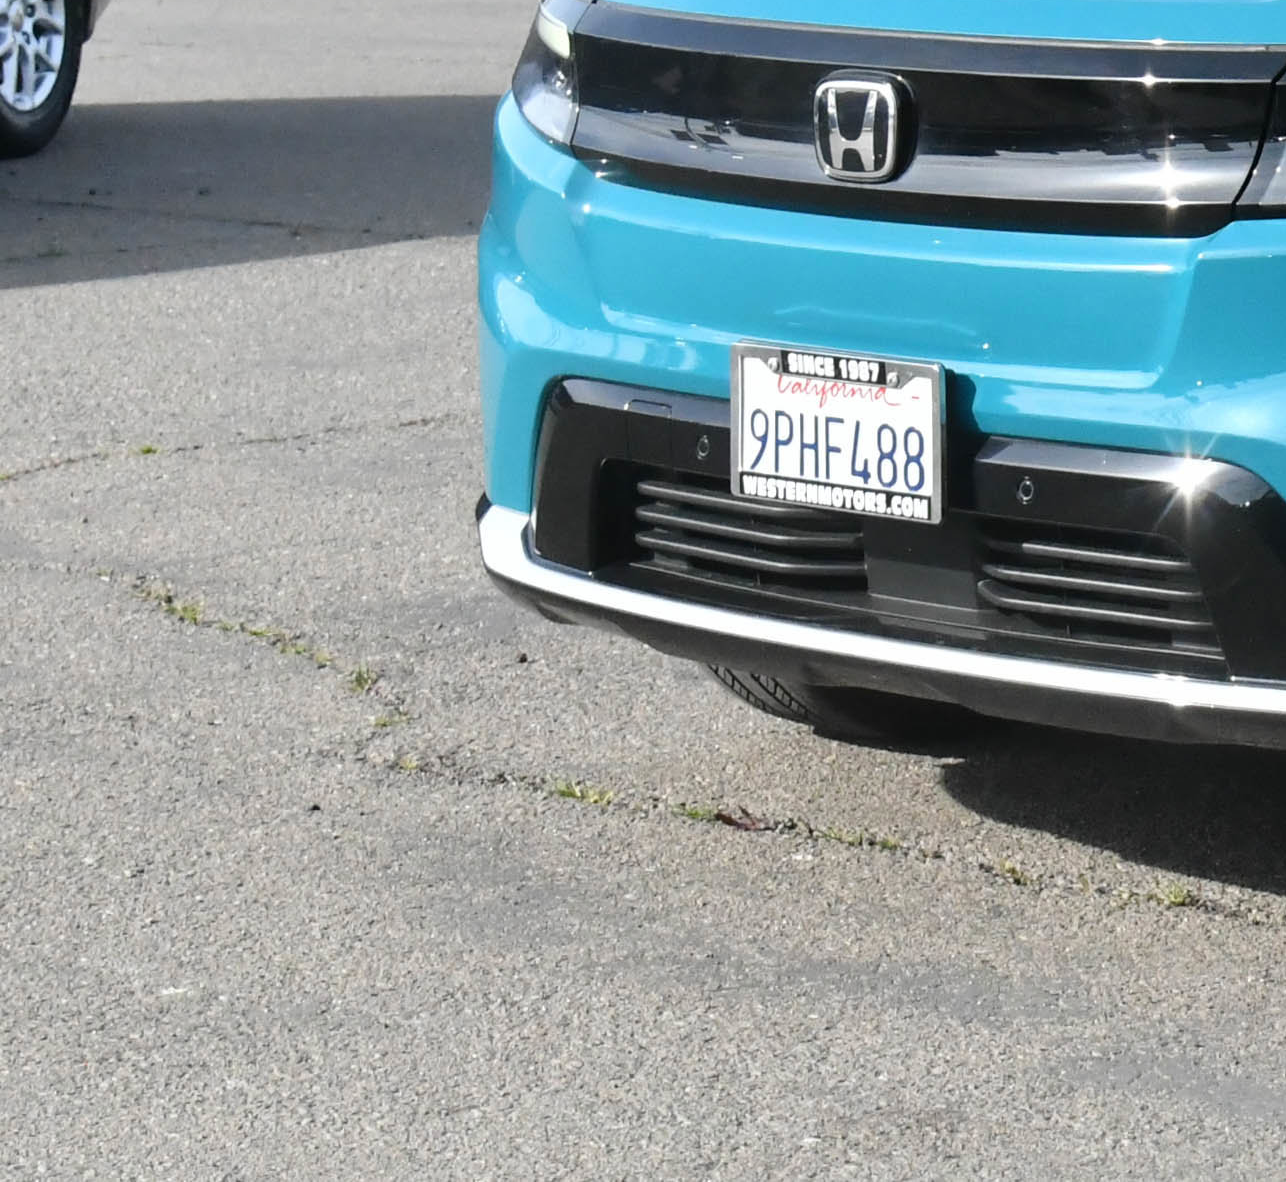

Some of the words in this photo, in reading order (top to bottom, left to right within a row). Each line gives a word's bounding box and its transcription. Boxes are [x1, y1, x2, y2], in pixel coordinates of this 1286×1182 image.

[787, 352, 836, 377] SINCE
[777, 374, 901, 408] California
[750, 409, 925, 492] 9PHF488
[742, 474, 929, 519] WESTERNMOTORS.COM
